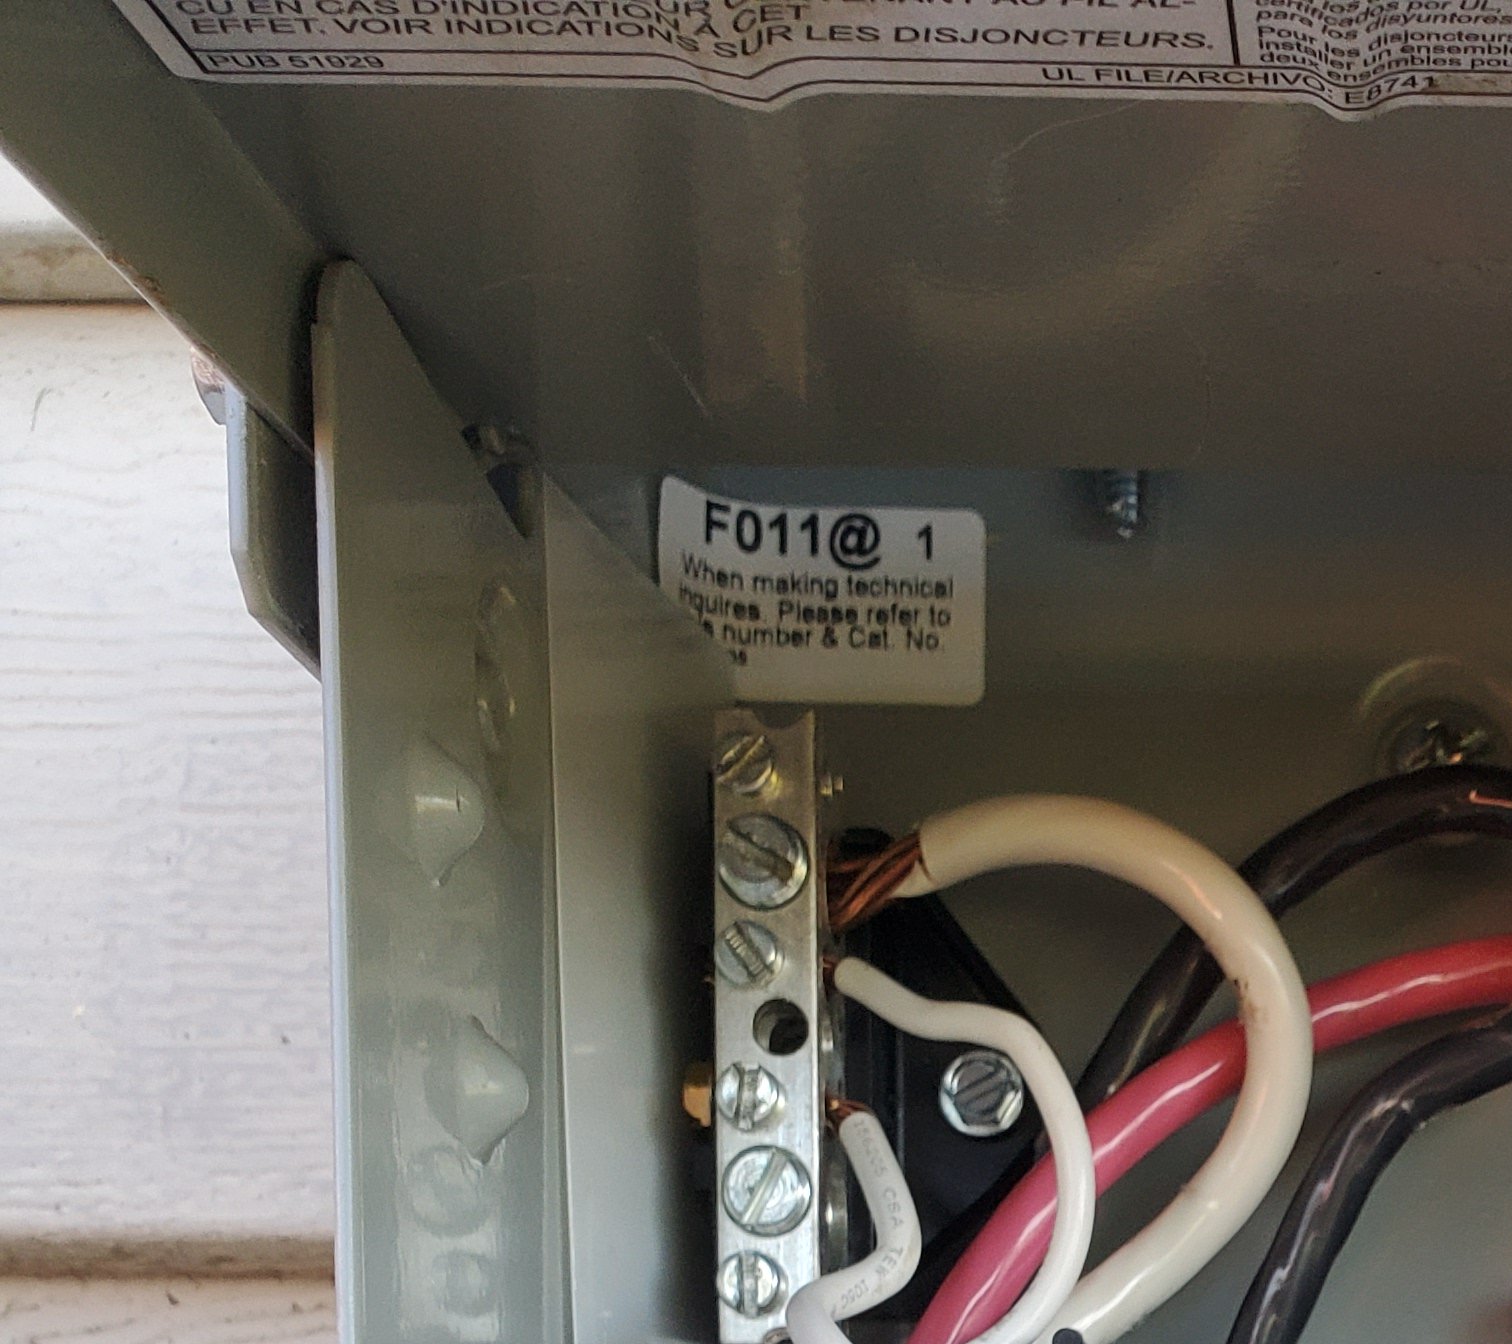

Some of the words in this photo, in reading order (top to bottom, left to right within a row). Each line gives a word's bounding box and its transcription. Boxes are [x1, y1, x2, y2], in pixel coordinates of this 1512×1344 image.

[248, 0, 304, 15] EN
[733, 5, 812, 33] CET
[1256, 10, 1313, 27] para
[1321, 24, 1358, 40] los
[334, 18, 433, 35] VOIR
[447, 19, 700, 52] INDICATIONS
[713, 25, 793, 58] SUR
[805, 25, 881, 42] LES
[894, 26, 1215, 50] DISJONCTEURS.
[1258, 26, 1317, 45] Pour
[1324, 42, 1361, 57] les
[206, 54, 281, 68] PUB
[1260, 52, 1320, 71] deux
[1363, 49, 1391, 67] un
[1042, 67, 1086, 82] UL
[1095, 67, 1333, 100] FILE/ARCHIVO:
[704, 500, 881, 571] F011@
[916, 524, 934, 561] 1
[681, 549, 744, 590] When
[929, 604, 951, 627] to
